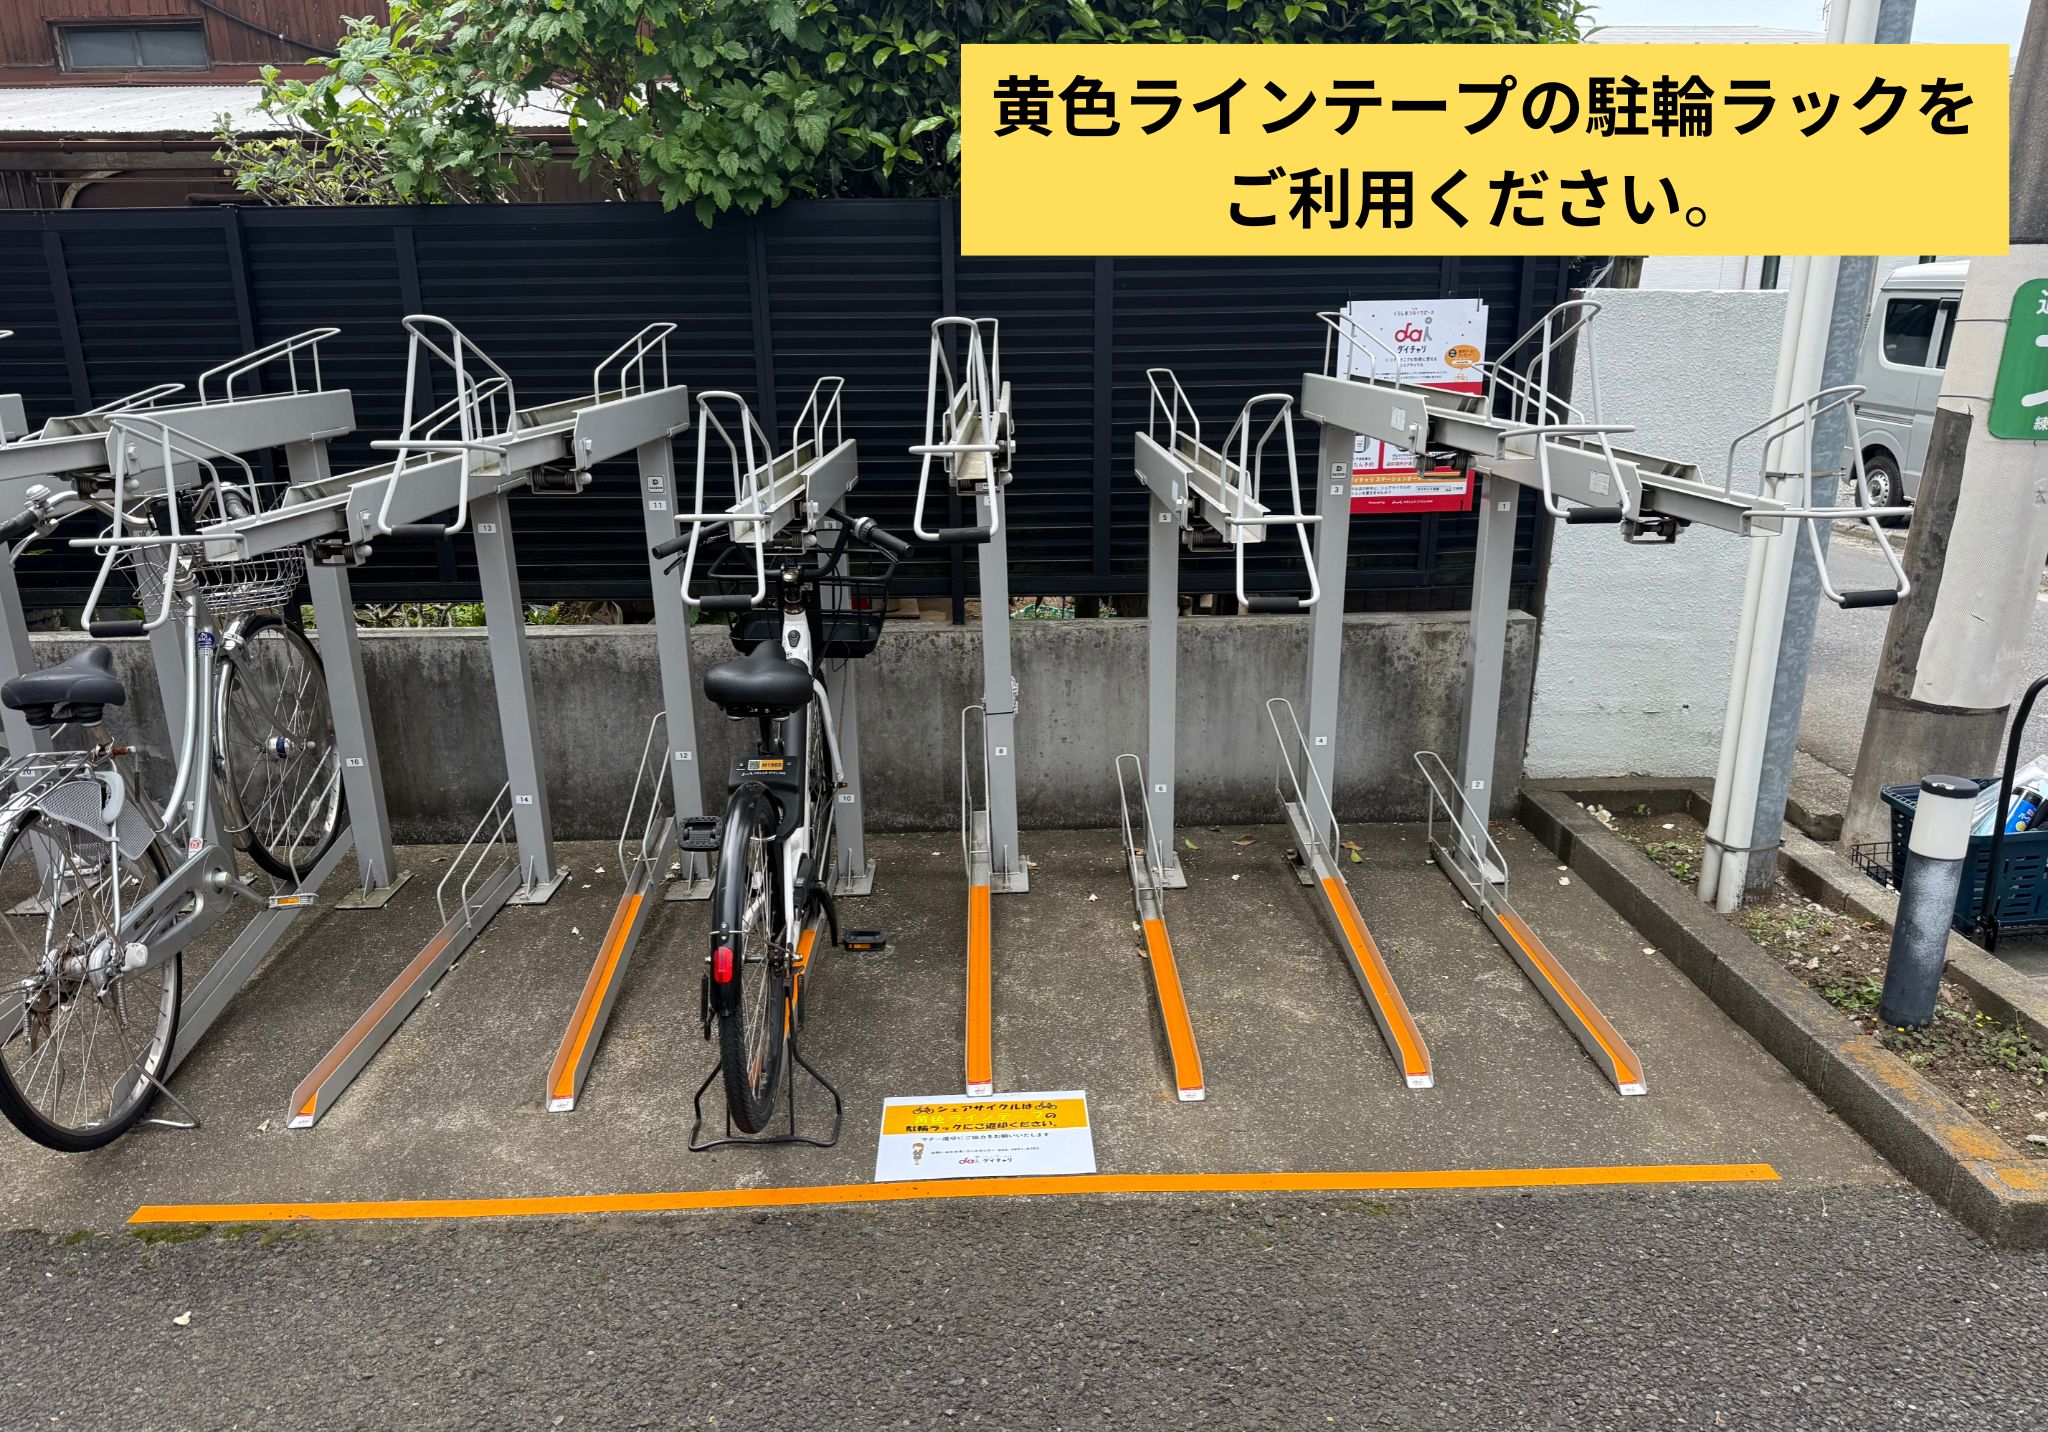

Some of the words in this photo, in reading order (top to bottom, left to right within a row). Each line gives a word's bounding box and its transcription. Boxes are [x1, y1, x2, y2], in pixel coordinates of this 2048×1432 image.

[1397, 345, 1428, 355] ダイチャリ
